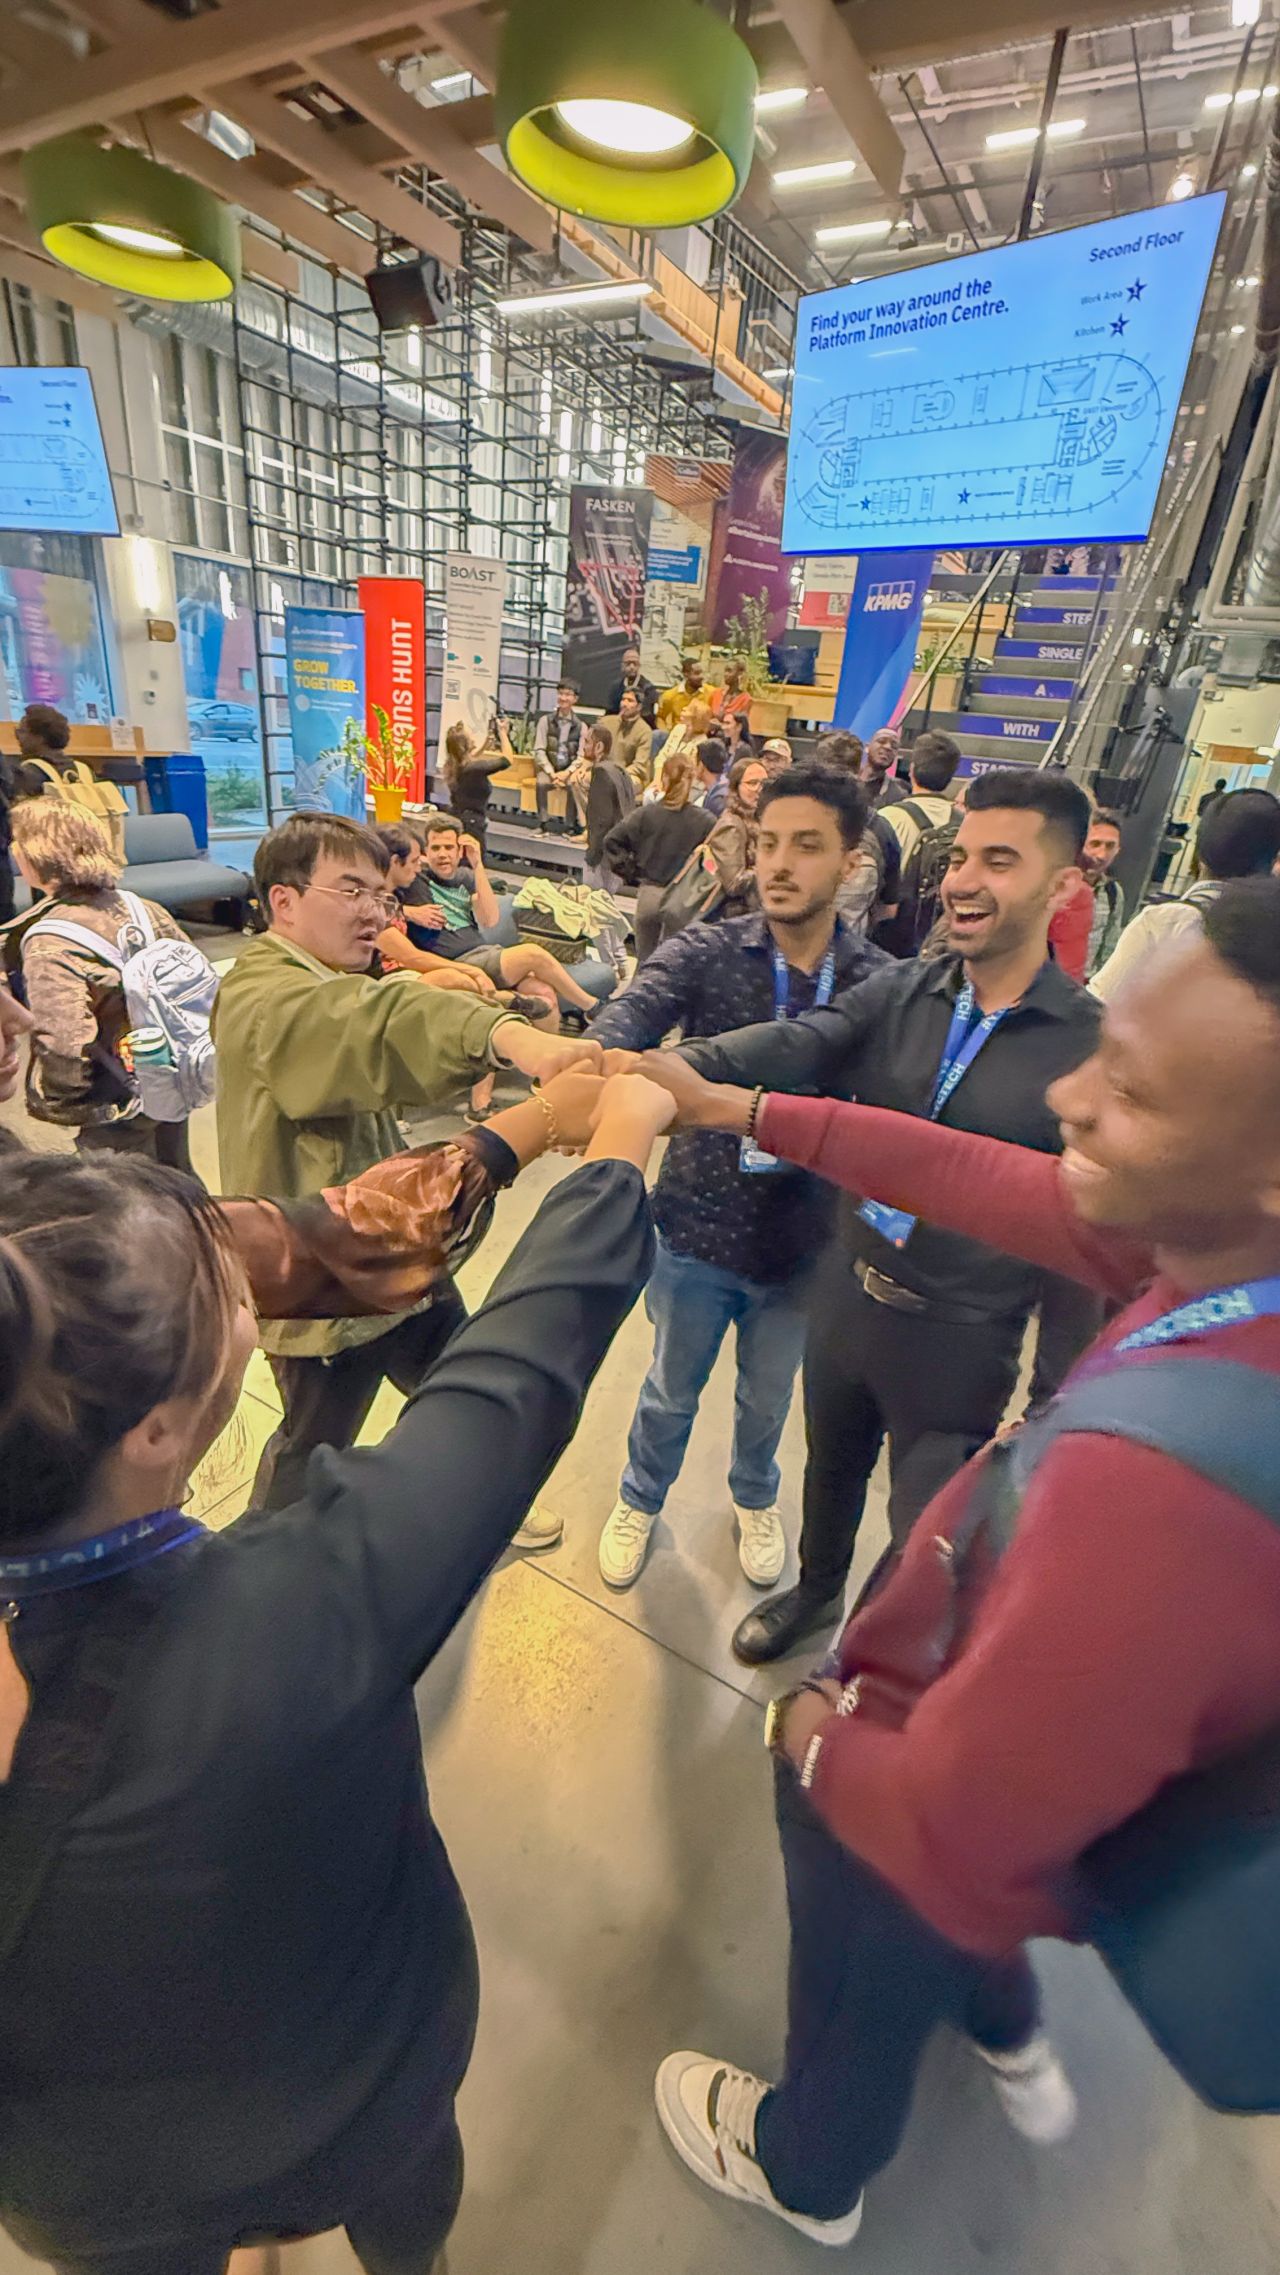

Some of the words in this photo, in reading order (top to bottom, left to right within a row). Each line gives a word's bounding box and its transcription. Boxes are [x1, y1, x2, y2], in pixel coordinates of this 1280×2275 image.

[1089, 236, 1142, 263] Second
[1145, 231, 1184, 250] Floor
[810, 311, 838, 332] Find
[842, 307, 872, 330] your
[876, 300, 905, 318] way
[908, 282, 962, 312] around
[966, 278, 992, 298] the
[809, 328, 866, 352] Platform
[869, 311, 948, 340] Innovation
[952, 299, 1009, 323] Centre.
[1074, 326, 1105, 337] Kitchen
[585, 498, 636, 513] FASKEN
[450, 566, 496, 582] BOAST
[863, 592, 913, 612] KPMG
[1038, 646, 1085, 660] SINGLE
[294, 659, 329, 674] GROW
[294, 675, 359, 694] TOGETHER.
[1034, 684, 1047, 696] A
[1003, 722, 1040, 737] WITH
